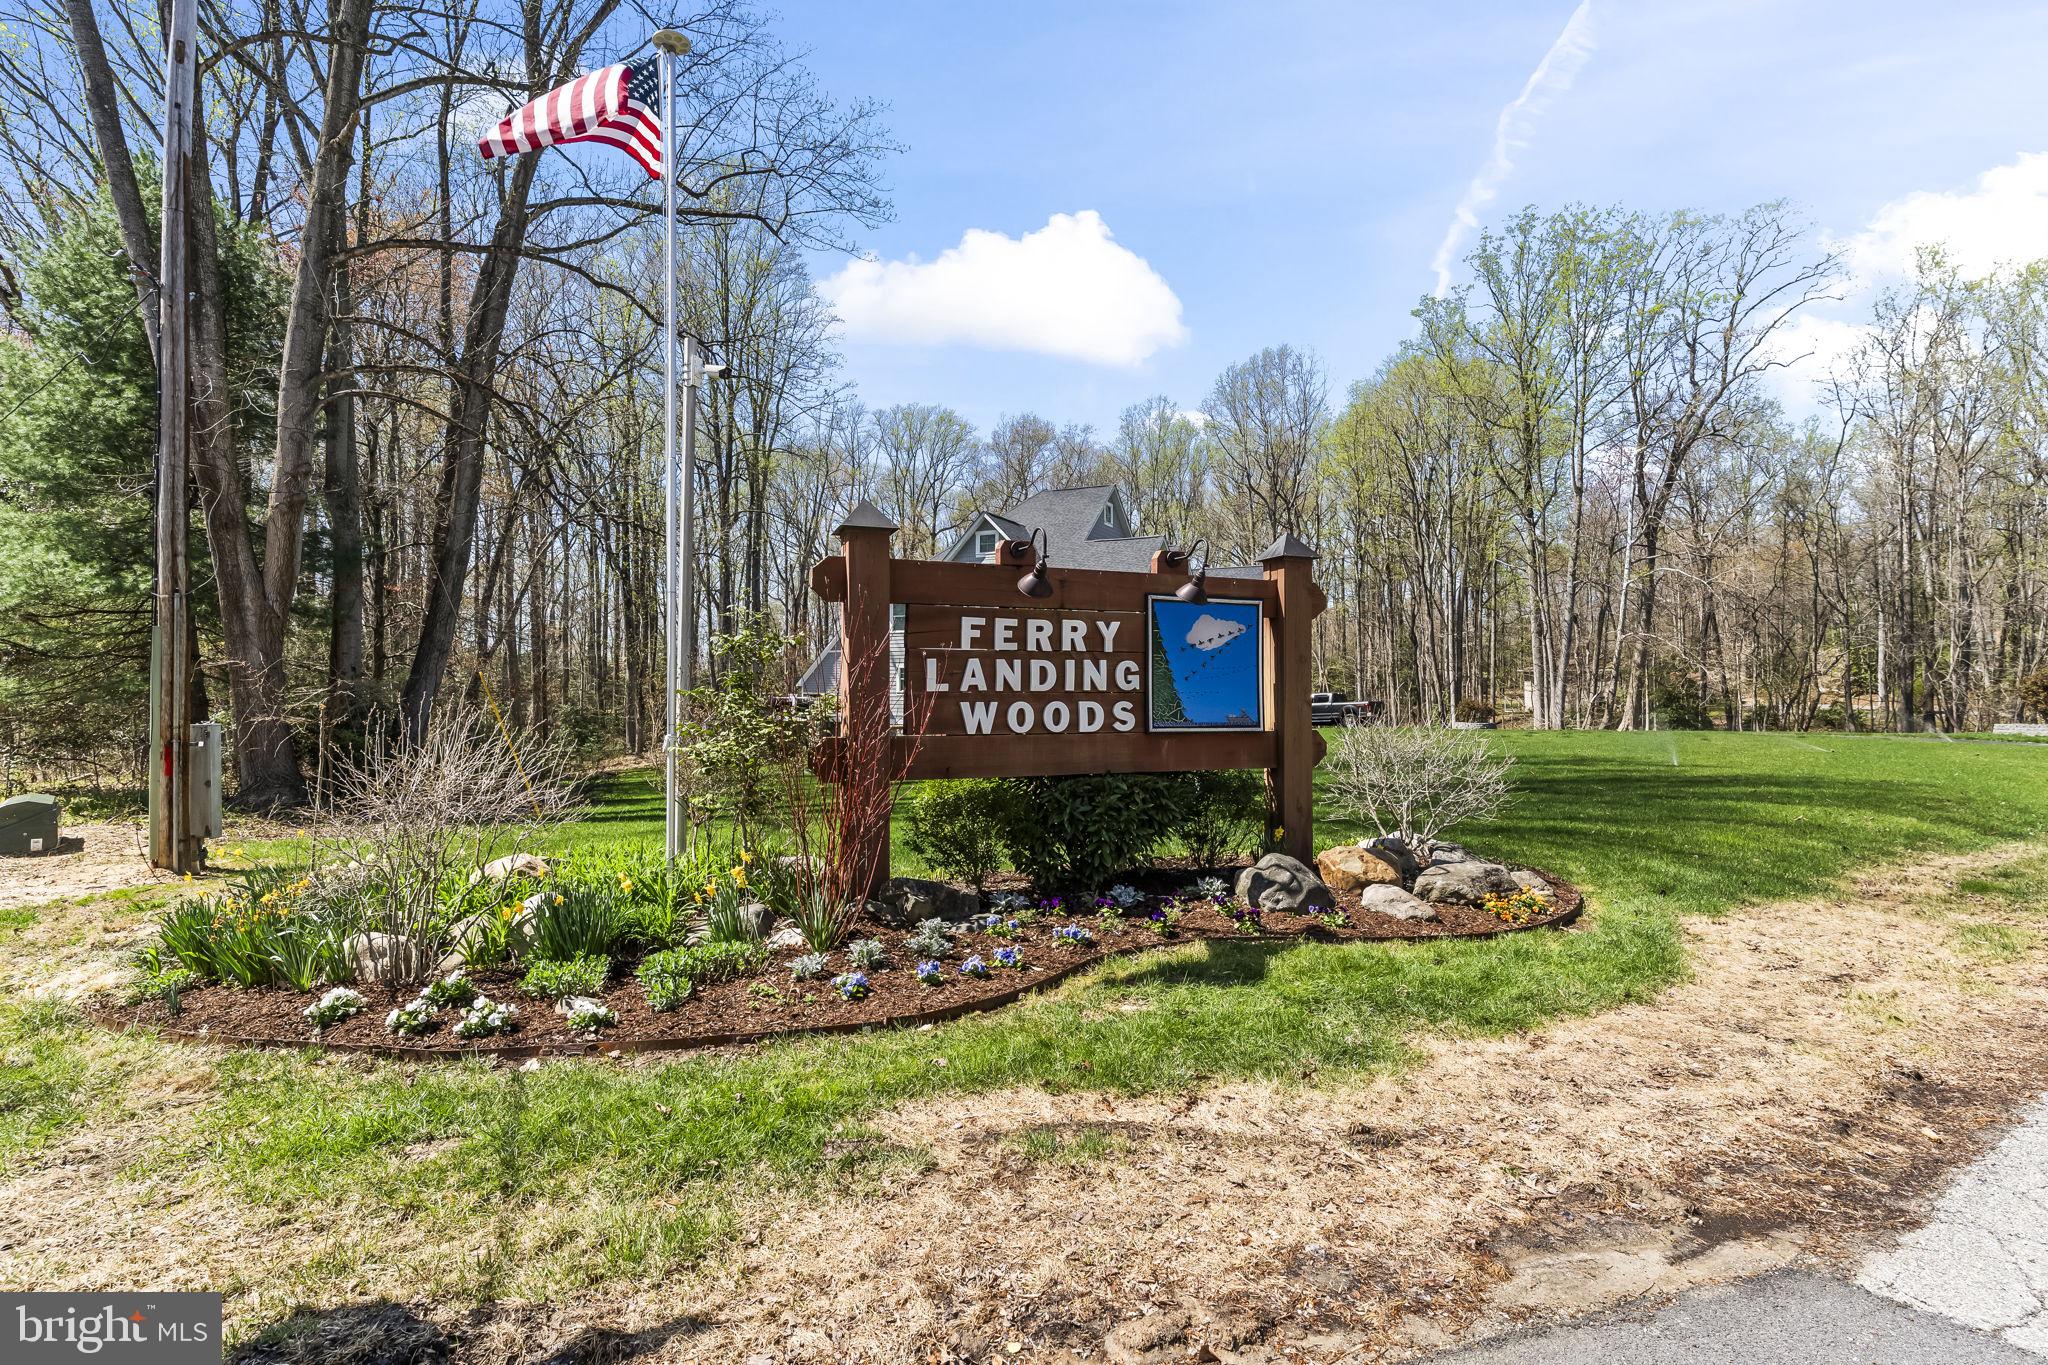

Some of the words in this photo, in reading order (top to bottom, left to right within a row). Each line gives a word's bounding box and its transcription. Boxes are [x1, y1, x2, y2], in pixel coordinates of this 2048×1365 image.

[960, 616, 1121, 653] FERRY
[926, 658, 1141, 692] LANDING
[959, 700, 1137, 735] WOODS
